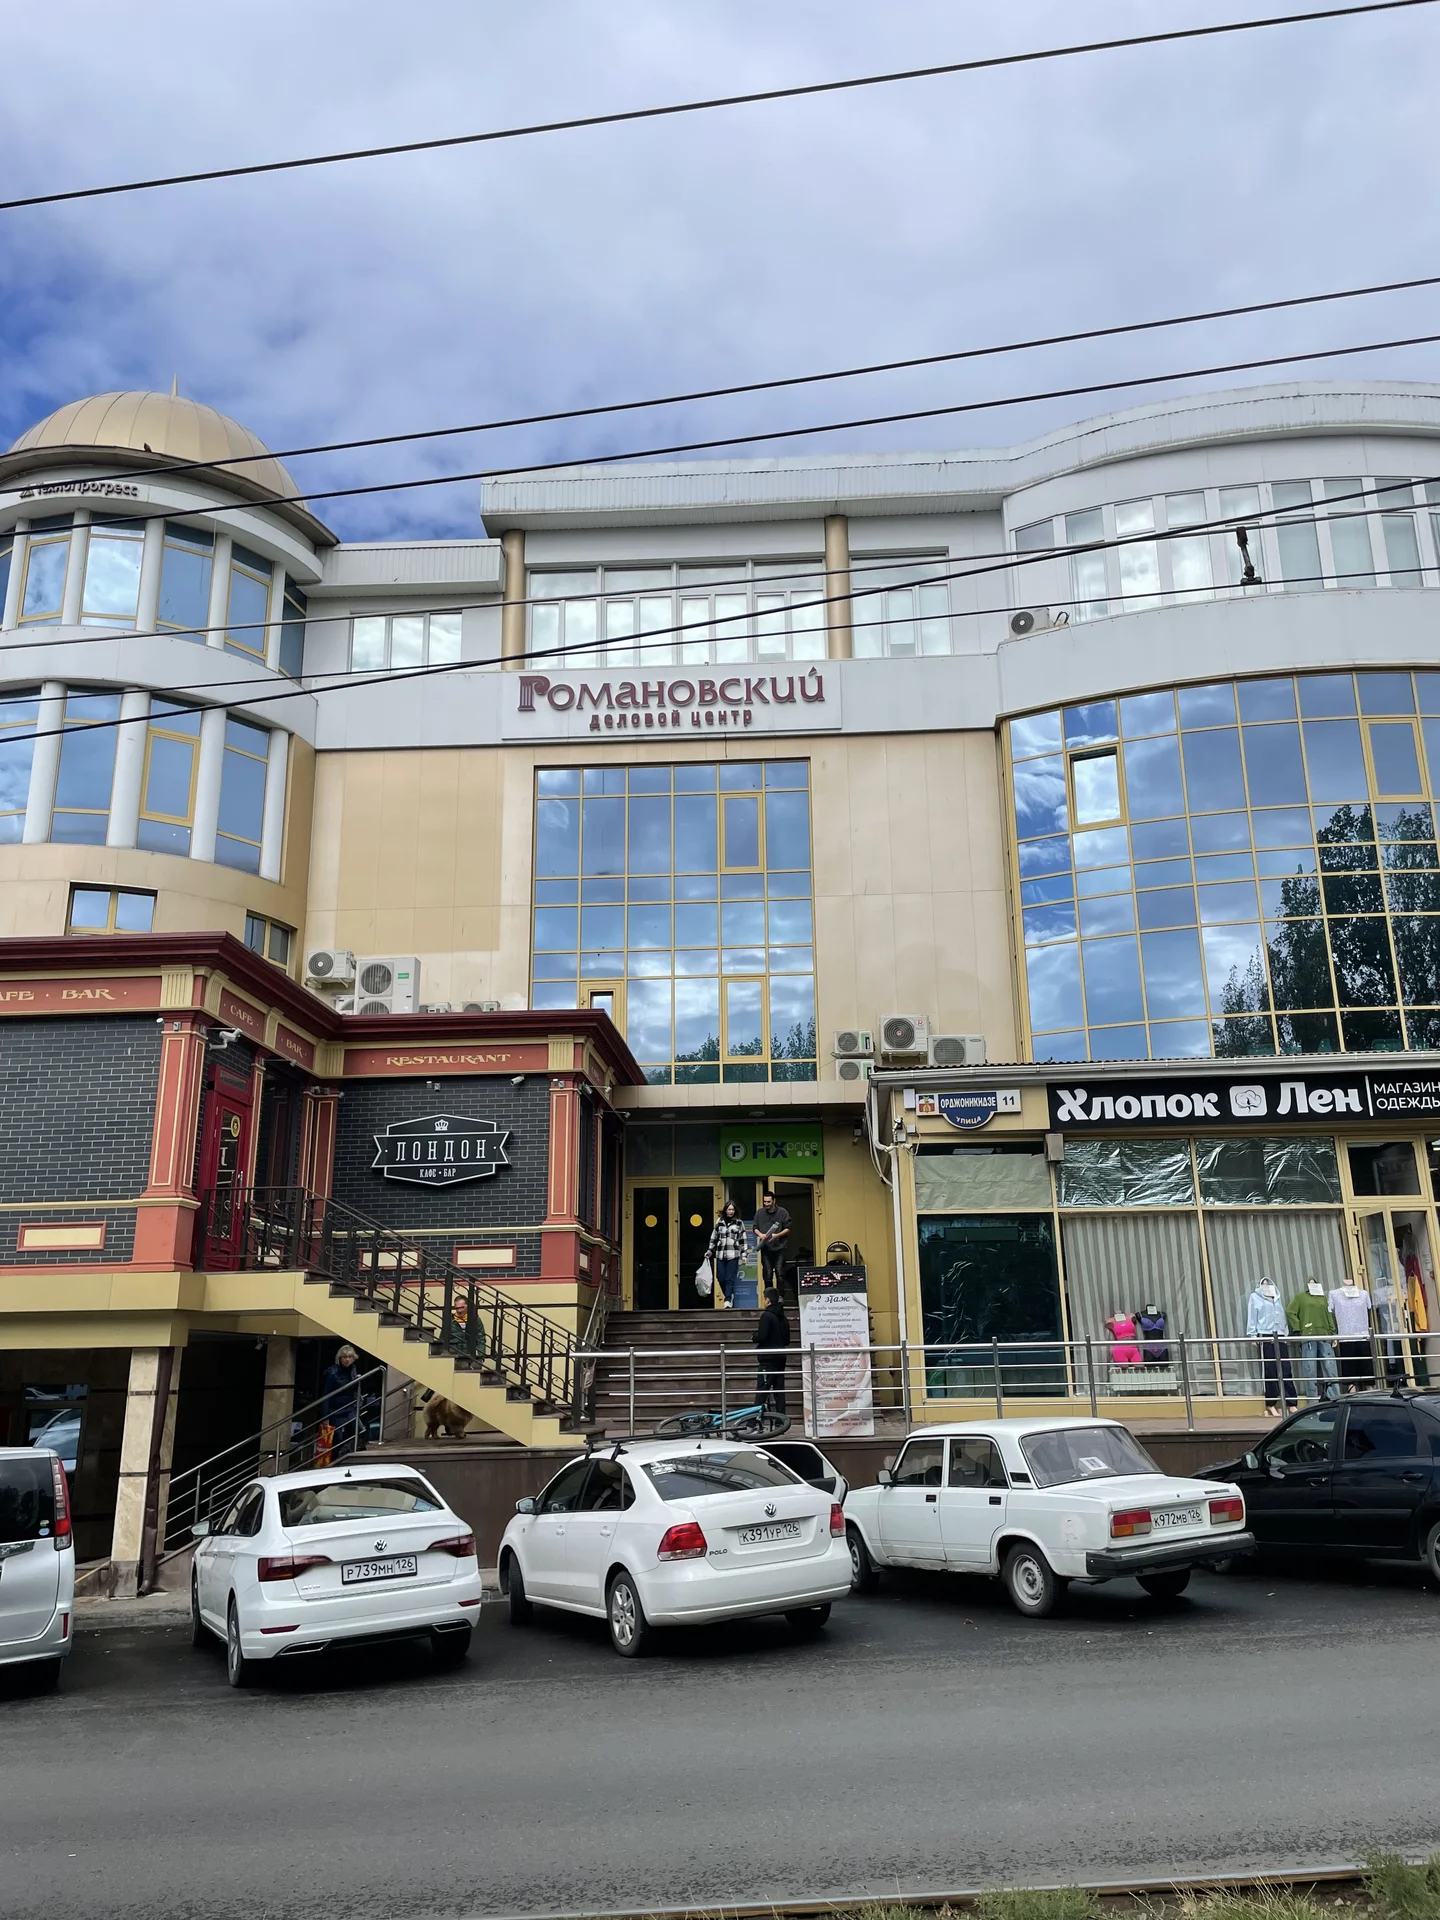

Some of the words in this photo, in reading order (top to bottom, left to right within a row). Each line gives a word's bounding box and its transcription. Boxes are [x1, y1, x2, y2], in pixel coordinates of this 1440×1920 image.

[517, 666, 826, 711] Романовский
[589, 710, 681, 731] деловой
[691, 708, 753, 727] центр
[61, 988, 117, 1000] BAR
[230, 1005, 254, 1026] CAFE
[286, 1039, 304, 1058] BAR
[386, 1053, 511, 1067] RESTAURANT
[1373, 1081, 1440, 1095] МАГАЗИН
[940, 1096, 997, 1109] ОРДЖОНИКИДЗЕ
[1002, 1095, 1016, 1106] 11
[1055, 1088, 1221, 1121] Хлопок
[1276, 1081, 1364, 1115] Лен
[955, 1115, 982, 1125] УЛИЦА
[395, 1139, 487, 1162] ЛОНДОН
[786, 1141, 819, 1153] price
[419, 1168, 437, 1178] КАФЕ
[443, 1167, 457, 1177] БАР
[815, 1294, 822, 1303] 2
[824, 1294, 851, 1304] этаж
[1187, 1509, 1202, 1519] 126
[709, 1548, 728, 1556] POLO
[346, 1562, 394, 1579] Р739МН
[395, 1558, 414, 1570] 126
